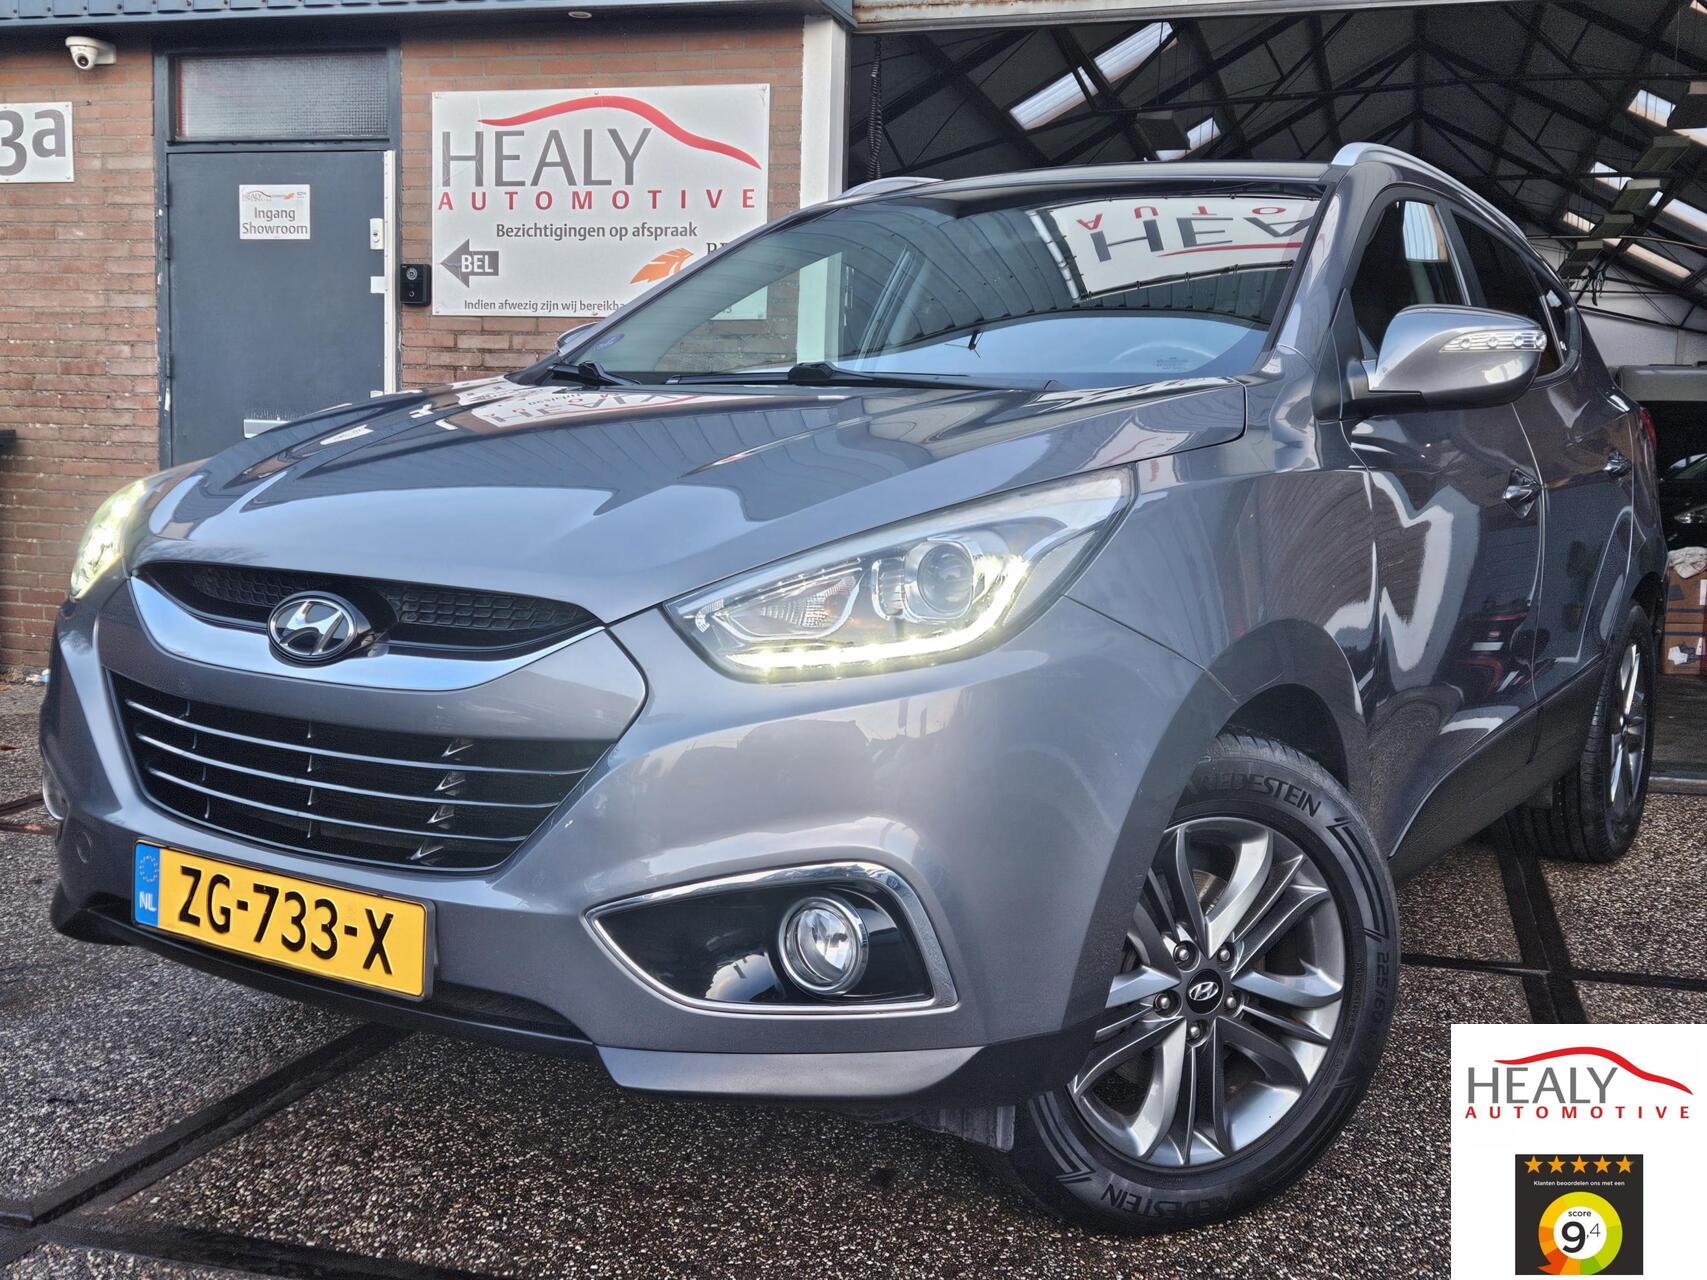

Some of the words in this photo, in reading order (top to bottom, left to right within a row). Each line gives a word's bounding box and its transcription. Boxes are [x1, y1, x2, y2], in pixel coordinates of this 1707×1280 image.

[0, 109, 66, 176] 3a
[442, 127, 651, 187] HEALY
[438, 188, 755, 210] AUTOMOTIVE
[254, 207, 296, 222] Ingang
[242, 221, 308, 235] Showroom
[496, 223, 606, 241] Bezichtigingen
[609, 225, 629, 241] op
[632, 222, 699, 241] afspraak
[461, 254, 494, 273] BEL
[464, 299, 496, 310] Indien
[498, 299, 538, 312] afwezig
[540, 299, 559, 313] zijn
[560, 300, 577, 313] wij
[138, 892, 158, 912] NL
[178, 865, 394, 976] ZG-733-X
